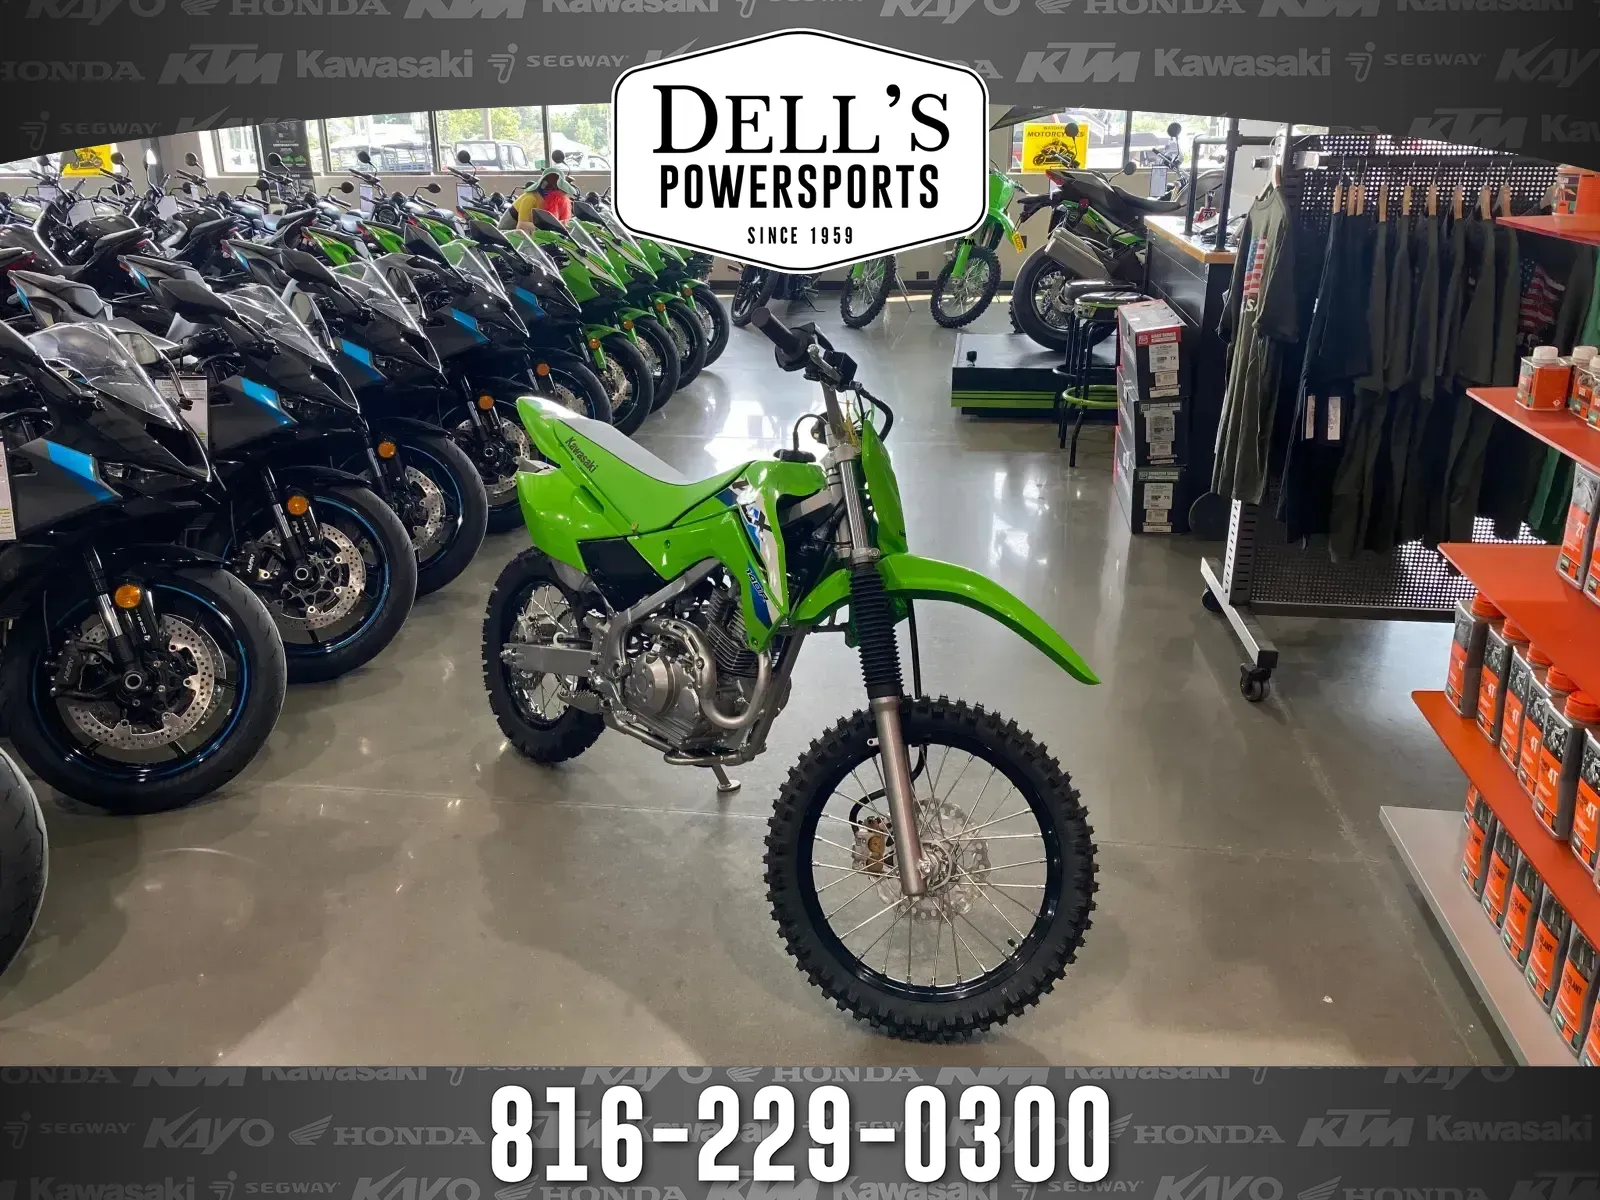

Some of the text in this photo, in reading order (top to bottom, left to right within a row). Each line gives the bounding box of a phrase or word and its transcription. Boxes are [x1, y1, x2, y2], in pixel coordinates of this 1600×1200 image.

[565, 436, 598, 474] Kawasaki
[1548, 767, 1558, 787] 4T
[1586, 801, 1598, 822] 4T
